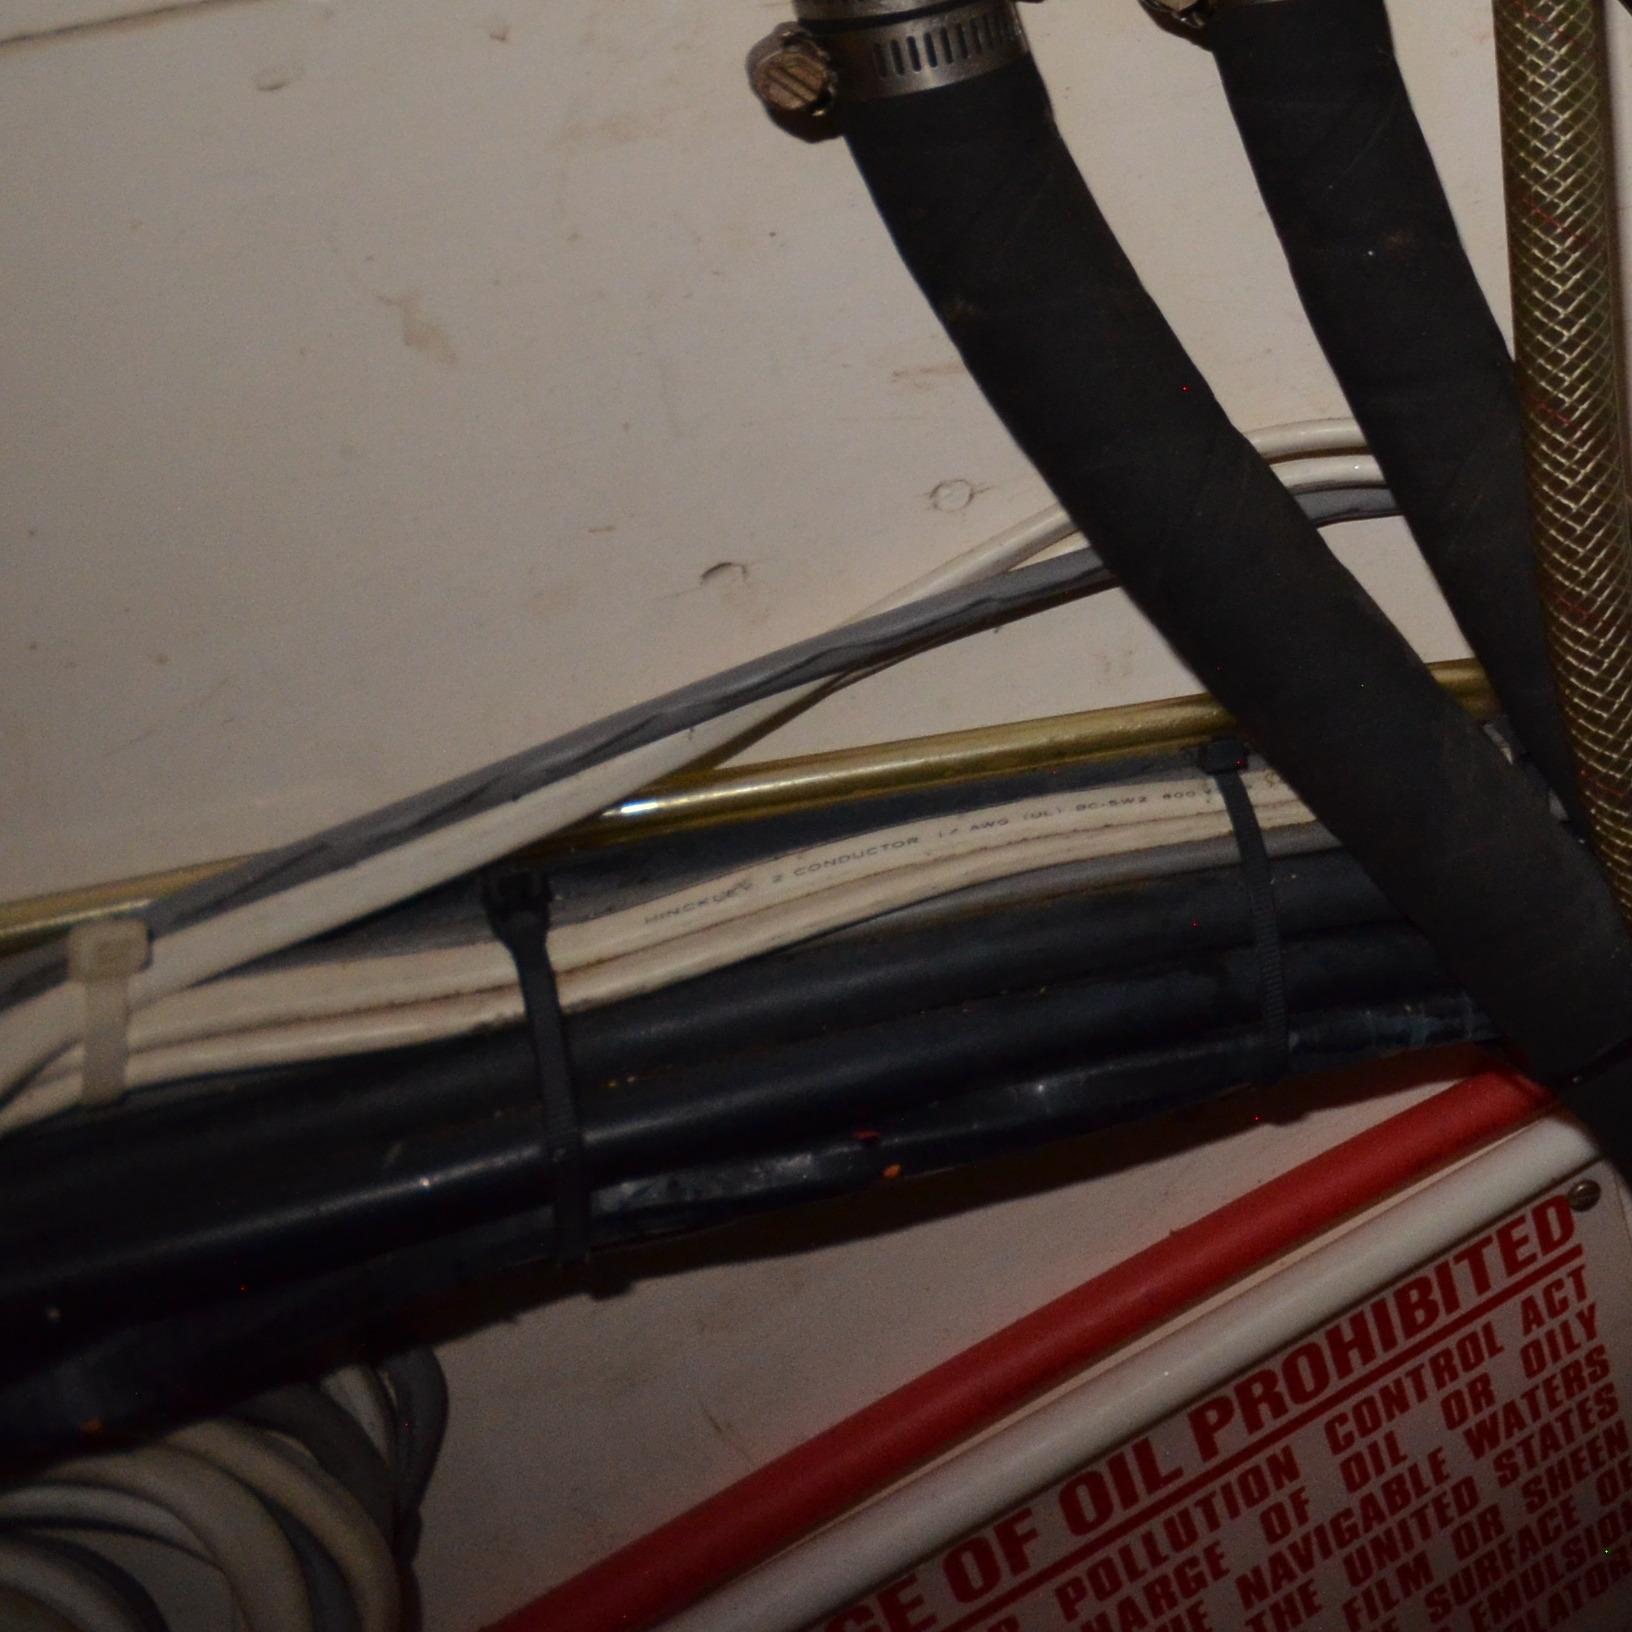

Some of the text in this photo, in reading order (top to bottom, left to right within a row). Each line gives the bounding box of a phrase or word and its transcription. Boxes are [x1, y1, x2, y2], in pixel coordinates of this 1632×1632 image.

[793, 836, 919, 877] CONDUCTOR
[970, 817, 1010, 834] AWG
[942, 1508, 1039, 1603] OF
[1059, 1438, 1183, 1536] OIL
[1187, 1193, 1576, 1462] PROHIBITED
[1055, 1264, 1587, 1623] POLLUTION CONTROL ACT
[1235, 1344, 1611, 1611] NAVIGABLE WATERS
[1259, 1486, 1311, 1545] OF
[1339, 1431, 1408, 1494] OIL
[1440, 1371, 1496, 1431] OR
[1520, 1304, 1599, 1379] OILY
[1341, 1475, 1480, 1587] UNITED
[1493, 1383, 1620, 1488] STATES
[1342, 1419, 1631, 1632] FILM OR SHEEN
[1424, 1494, 1580, 1624] SURFACE
